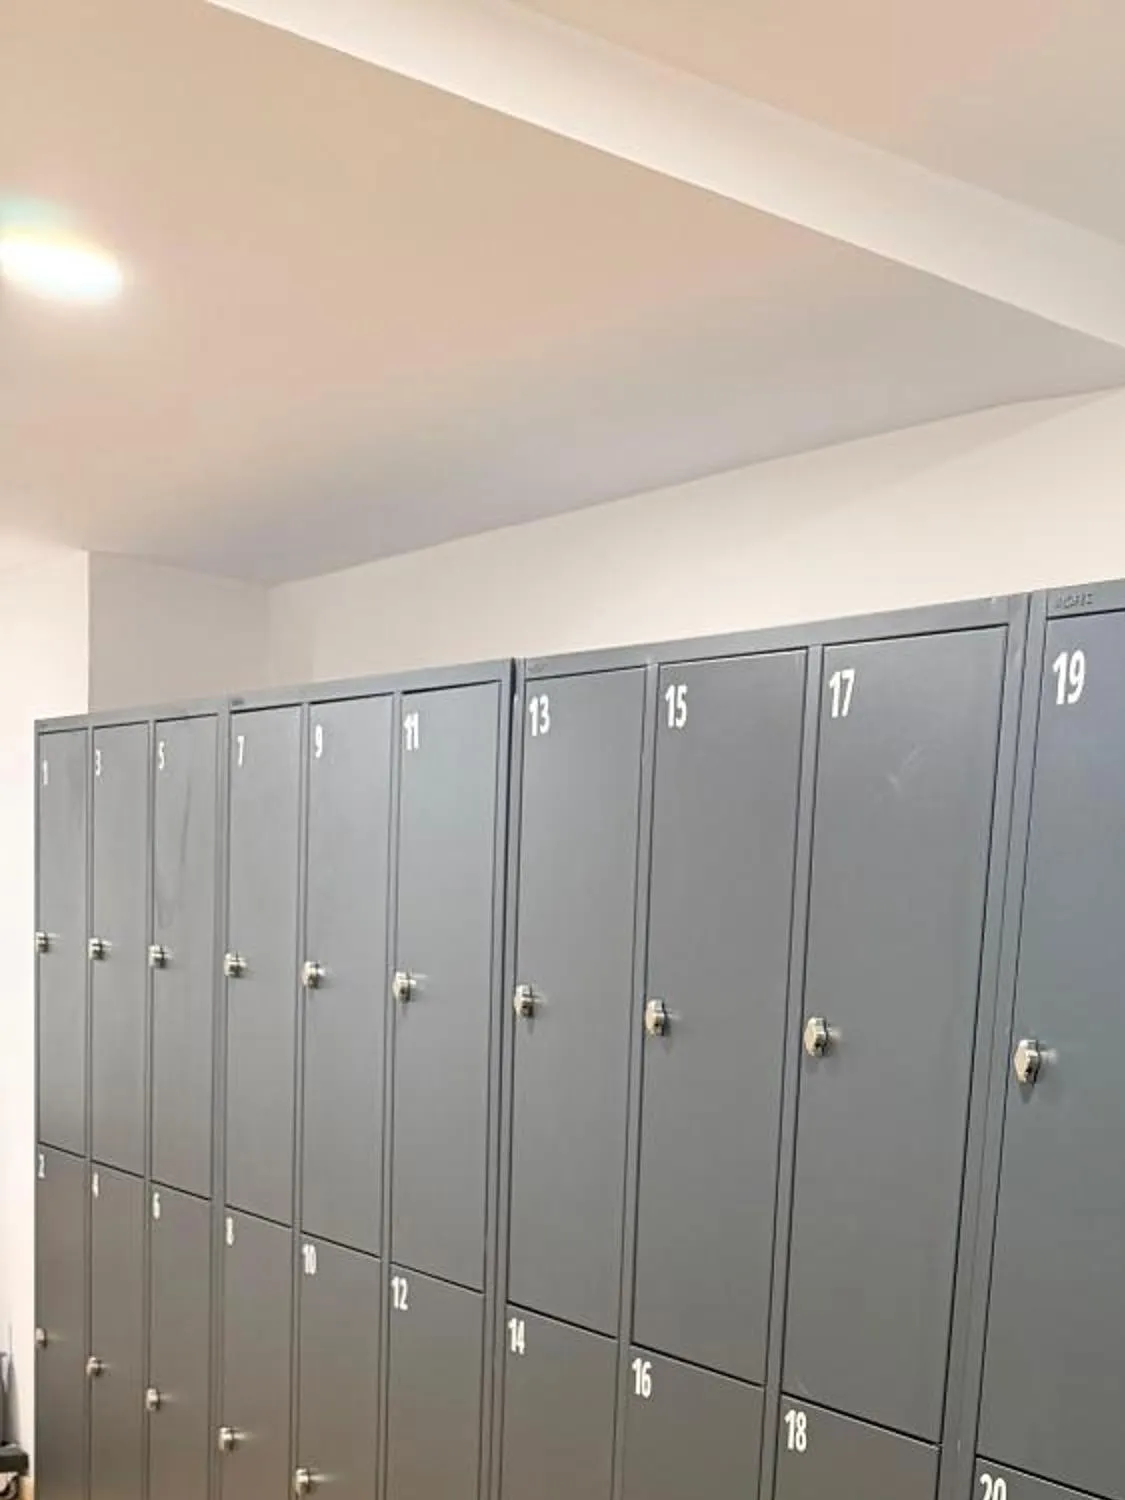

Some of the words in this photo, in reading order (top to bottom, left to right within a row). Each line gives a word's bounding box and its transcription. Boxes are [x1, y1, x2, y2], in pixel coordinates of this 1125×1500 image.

[828, 668, 856, 718] 17
[1052, 649, 1086, 705] 19
[528, 694, 550, 737] 13
[664, 684, 688, 729] 15
[237, 735, 245, 766] 7
[315, 724, 323, 759] 9
[403, 712, 419, 751] 11
[95, 749, 102, 777] 3
[158, 741, 165, 771] 5
[302, 1243, 317, 1275] 10
[391, 1276, 409, 1311] 12
[508, 1317, 525, 1355] 14
[631, 1357, 652, 1398] 16
[784, 1409, 807, 1452] 18
